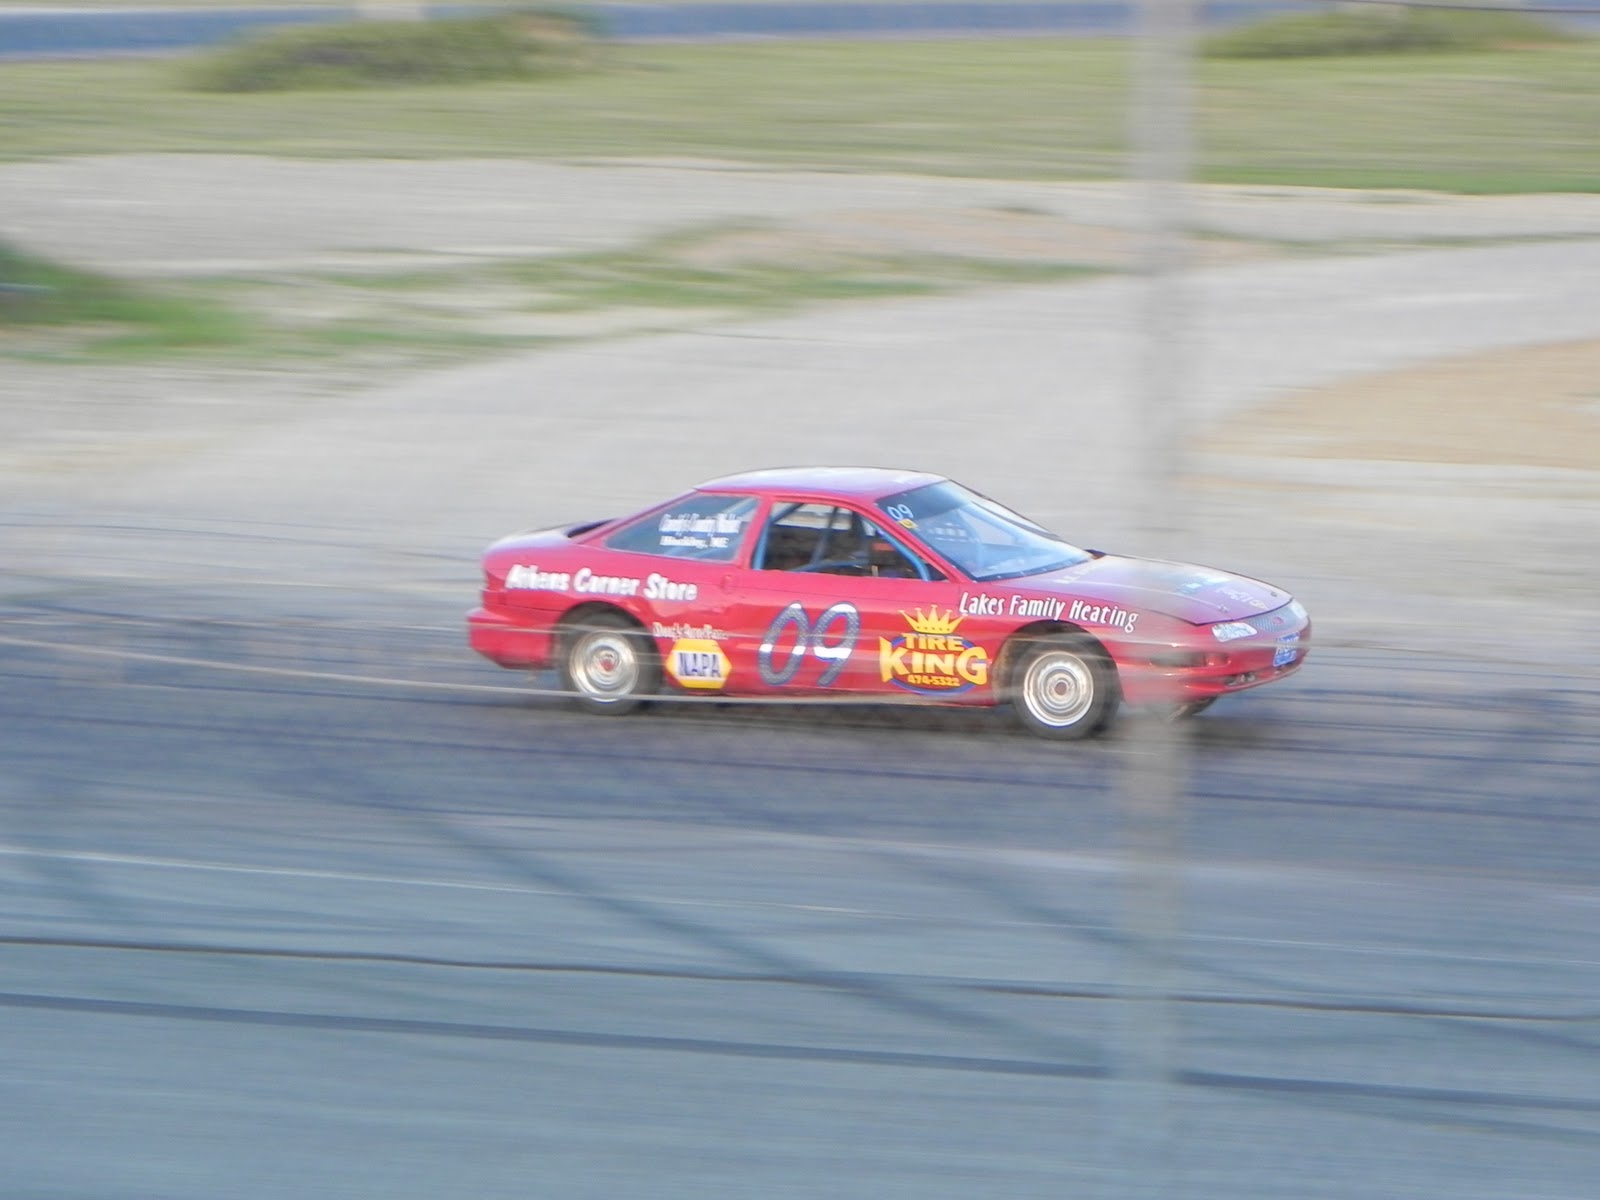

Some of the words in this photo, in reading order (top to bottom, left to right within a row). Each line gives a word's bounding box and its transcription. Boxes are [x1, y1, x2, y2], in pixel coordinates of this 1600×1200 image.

[886, 504, 914, 520] 09
[573, 567, 640, 596] Corner
[643, 573, 698, 600] Store
[959, 592, 1005, 616] Lakes
[1008, 595, 1066, 621] Family
[1069, 600, 1139, 633] Heating
[757, 601, 861, 687] 09
[901, 632, 965, 652] TIRE
[679, 652, 722, 677] NAPA
[879, 635, 988, 685] KING
